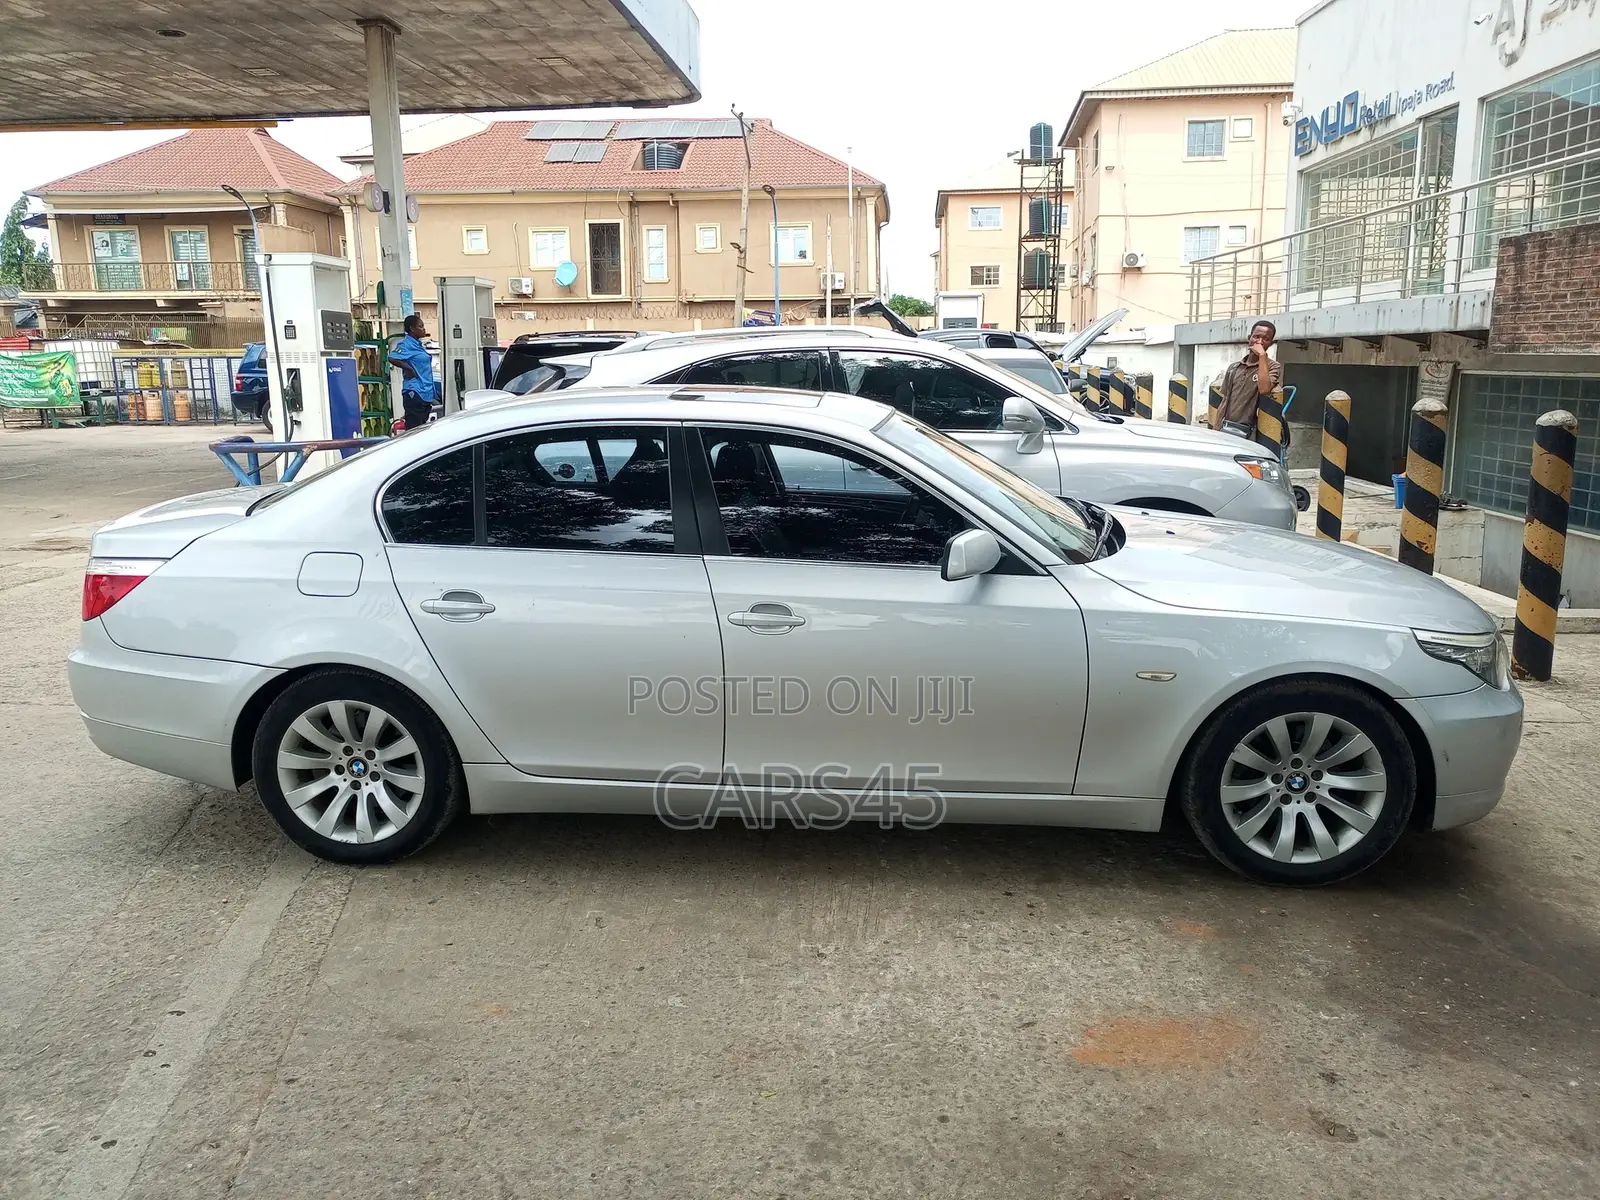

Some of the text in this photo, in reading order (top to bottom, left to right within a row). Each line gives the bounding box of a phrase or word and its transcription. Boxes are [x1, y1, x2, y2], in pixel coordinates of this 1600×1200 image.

[1294, 90, 1359, 156] ENYO
[1359, 92, 1392, 126] Retail
[1398, 90, 1423, 117] Ipaja
